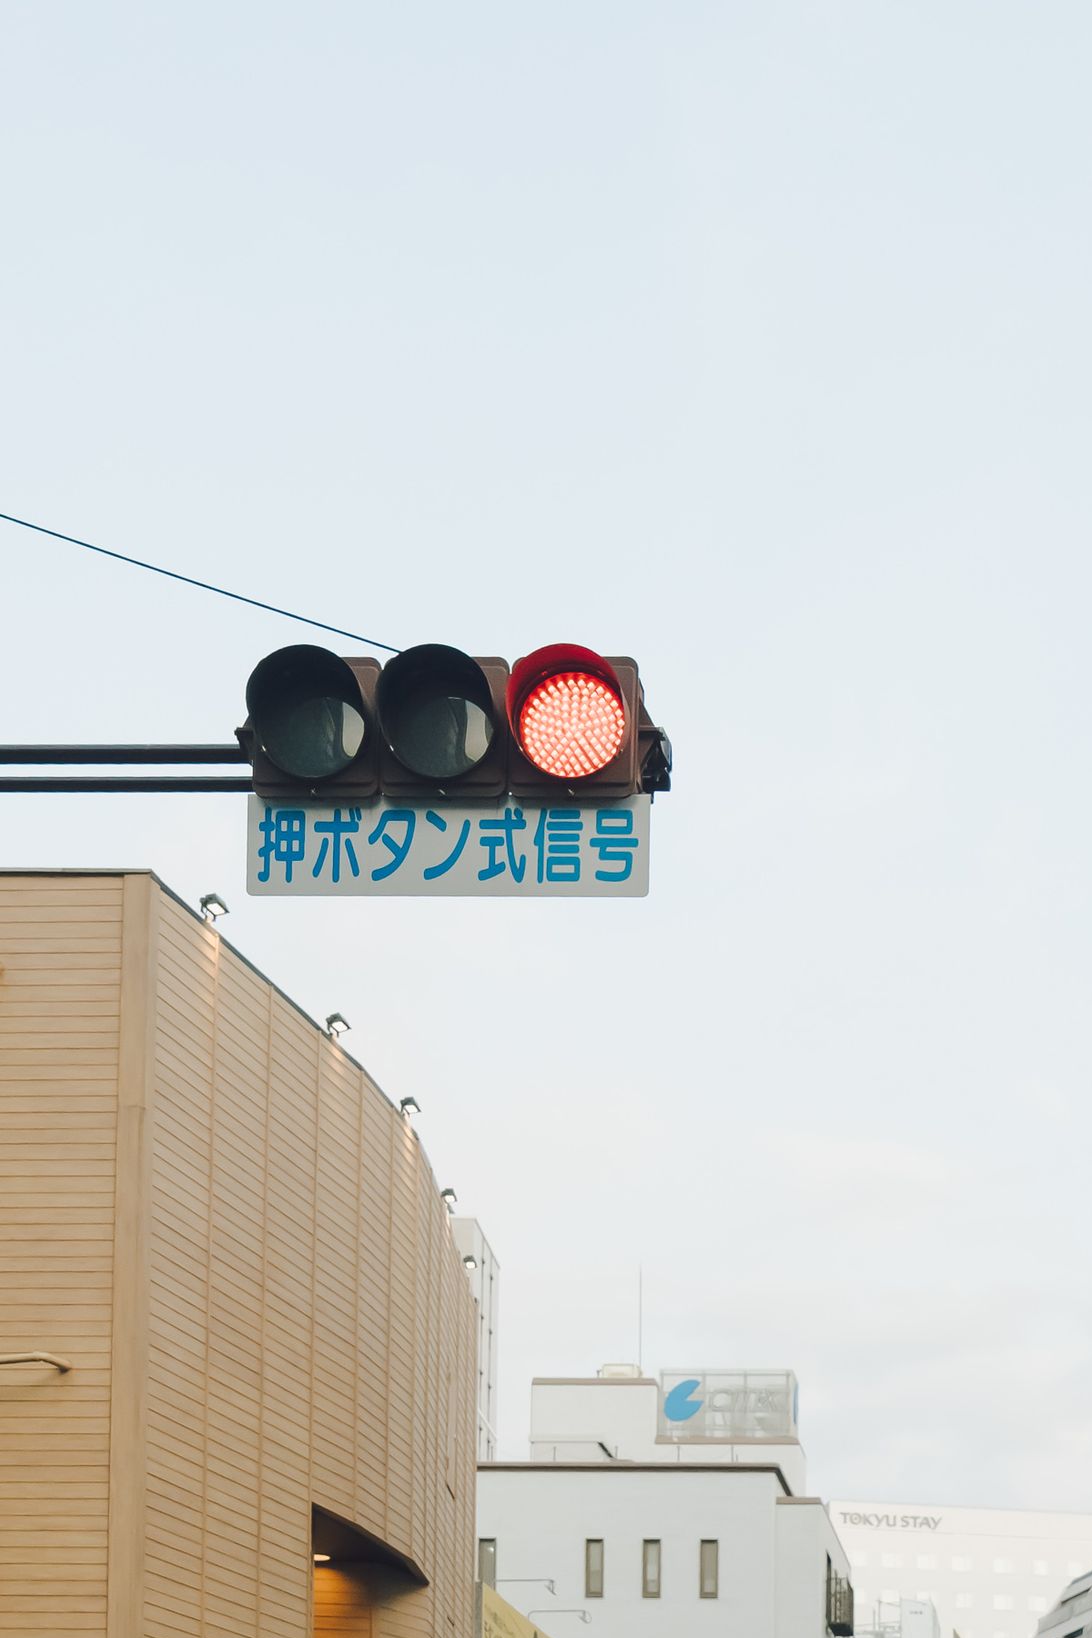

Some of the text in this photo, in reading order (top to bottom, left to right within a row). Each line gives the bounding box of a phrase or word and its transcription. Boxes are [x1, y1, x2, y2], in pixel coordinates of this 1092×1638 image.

[258, 806, 639, 884] 押ボタン式信号
[840, 1512, 942, 1530] TOKYU STAY
